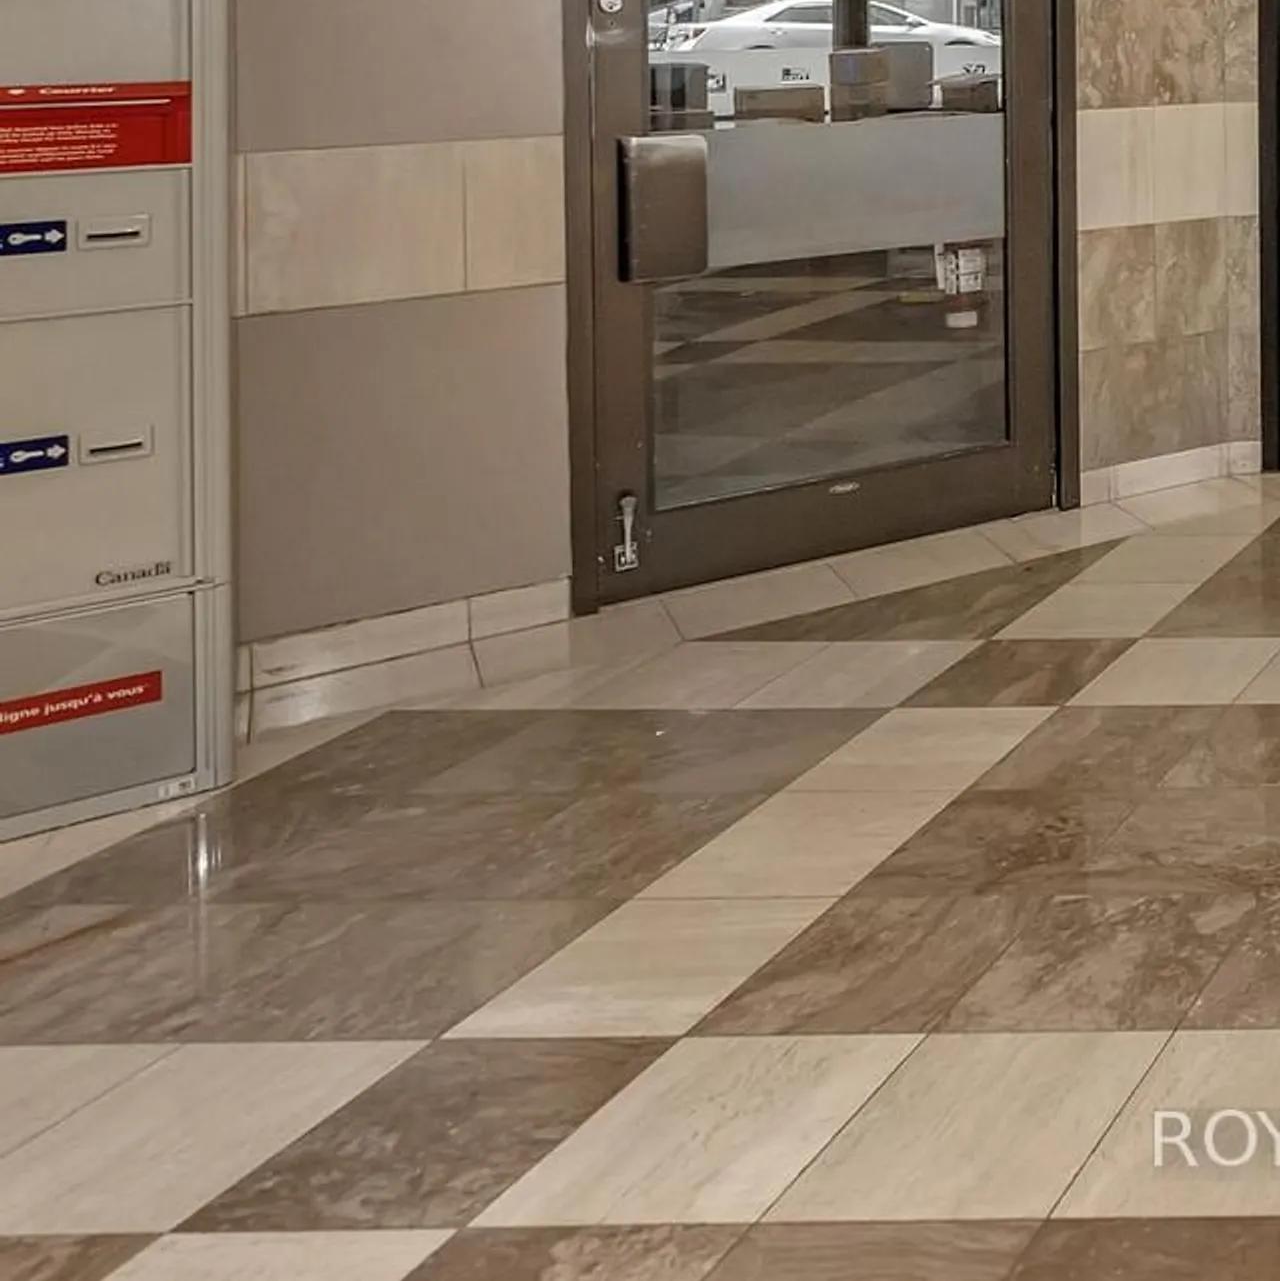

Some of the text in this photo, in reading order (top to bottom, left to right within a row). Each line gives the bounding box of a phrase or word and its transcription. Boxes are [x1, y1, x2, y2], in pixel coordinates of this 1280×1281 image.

[95, 563, 171, 587] Canada
[44, 691, 102, 717] jusqu'à
[107, 685, 144, 700] vous
